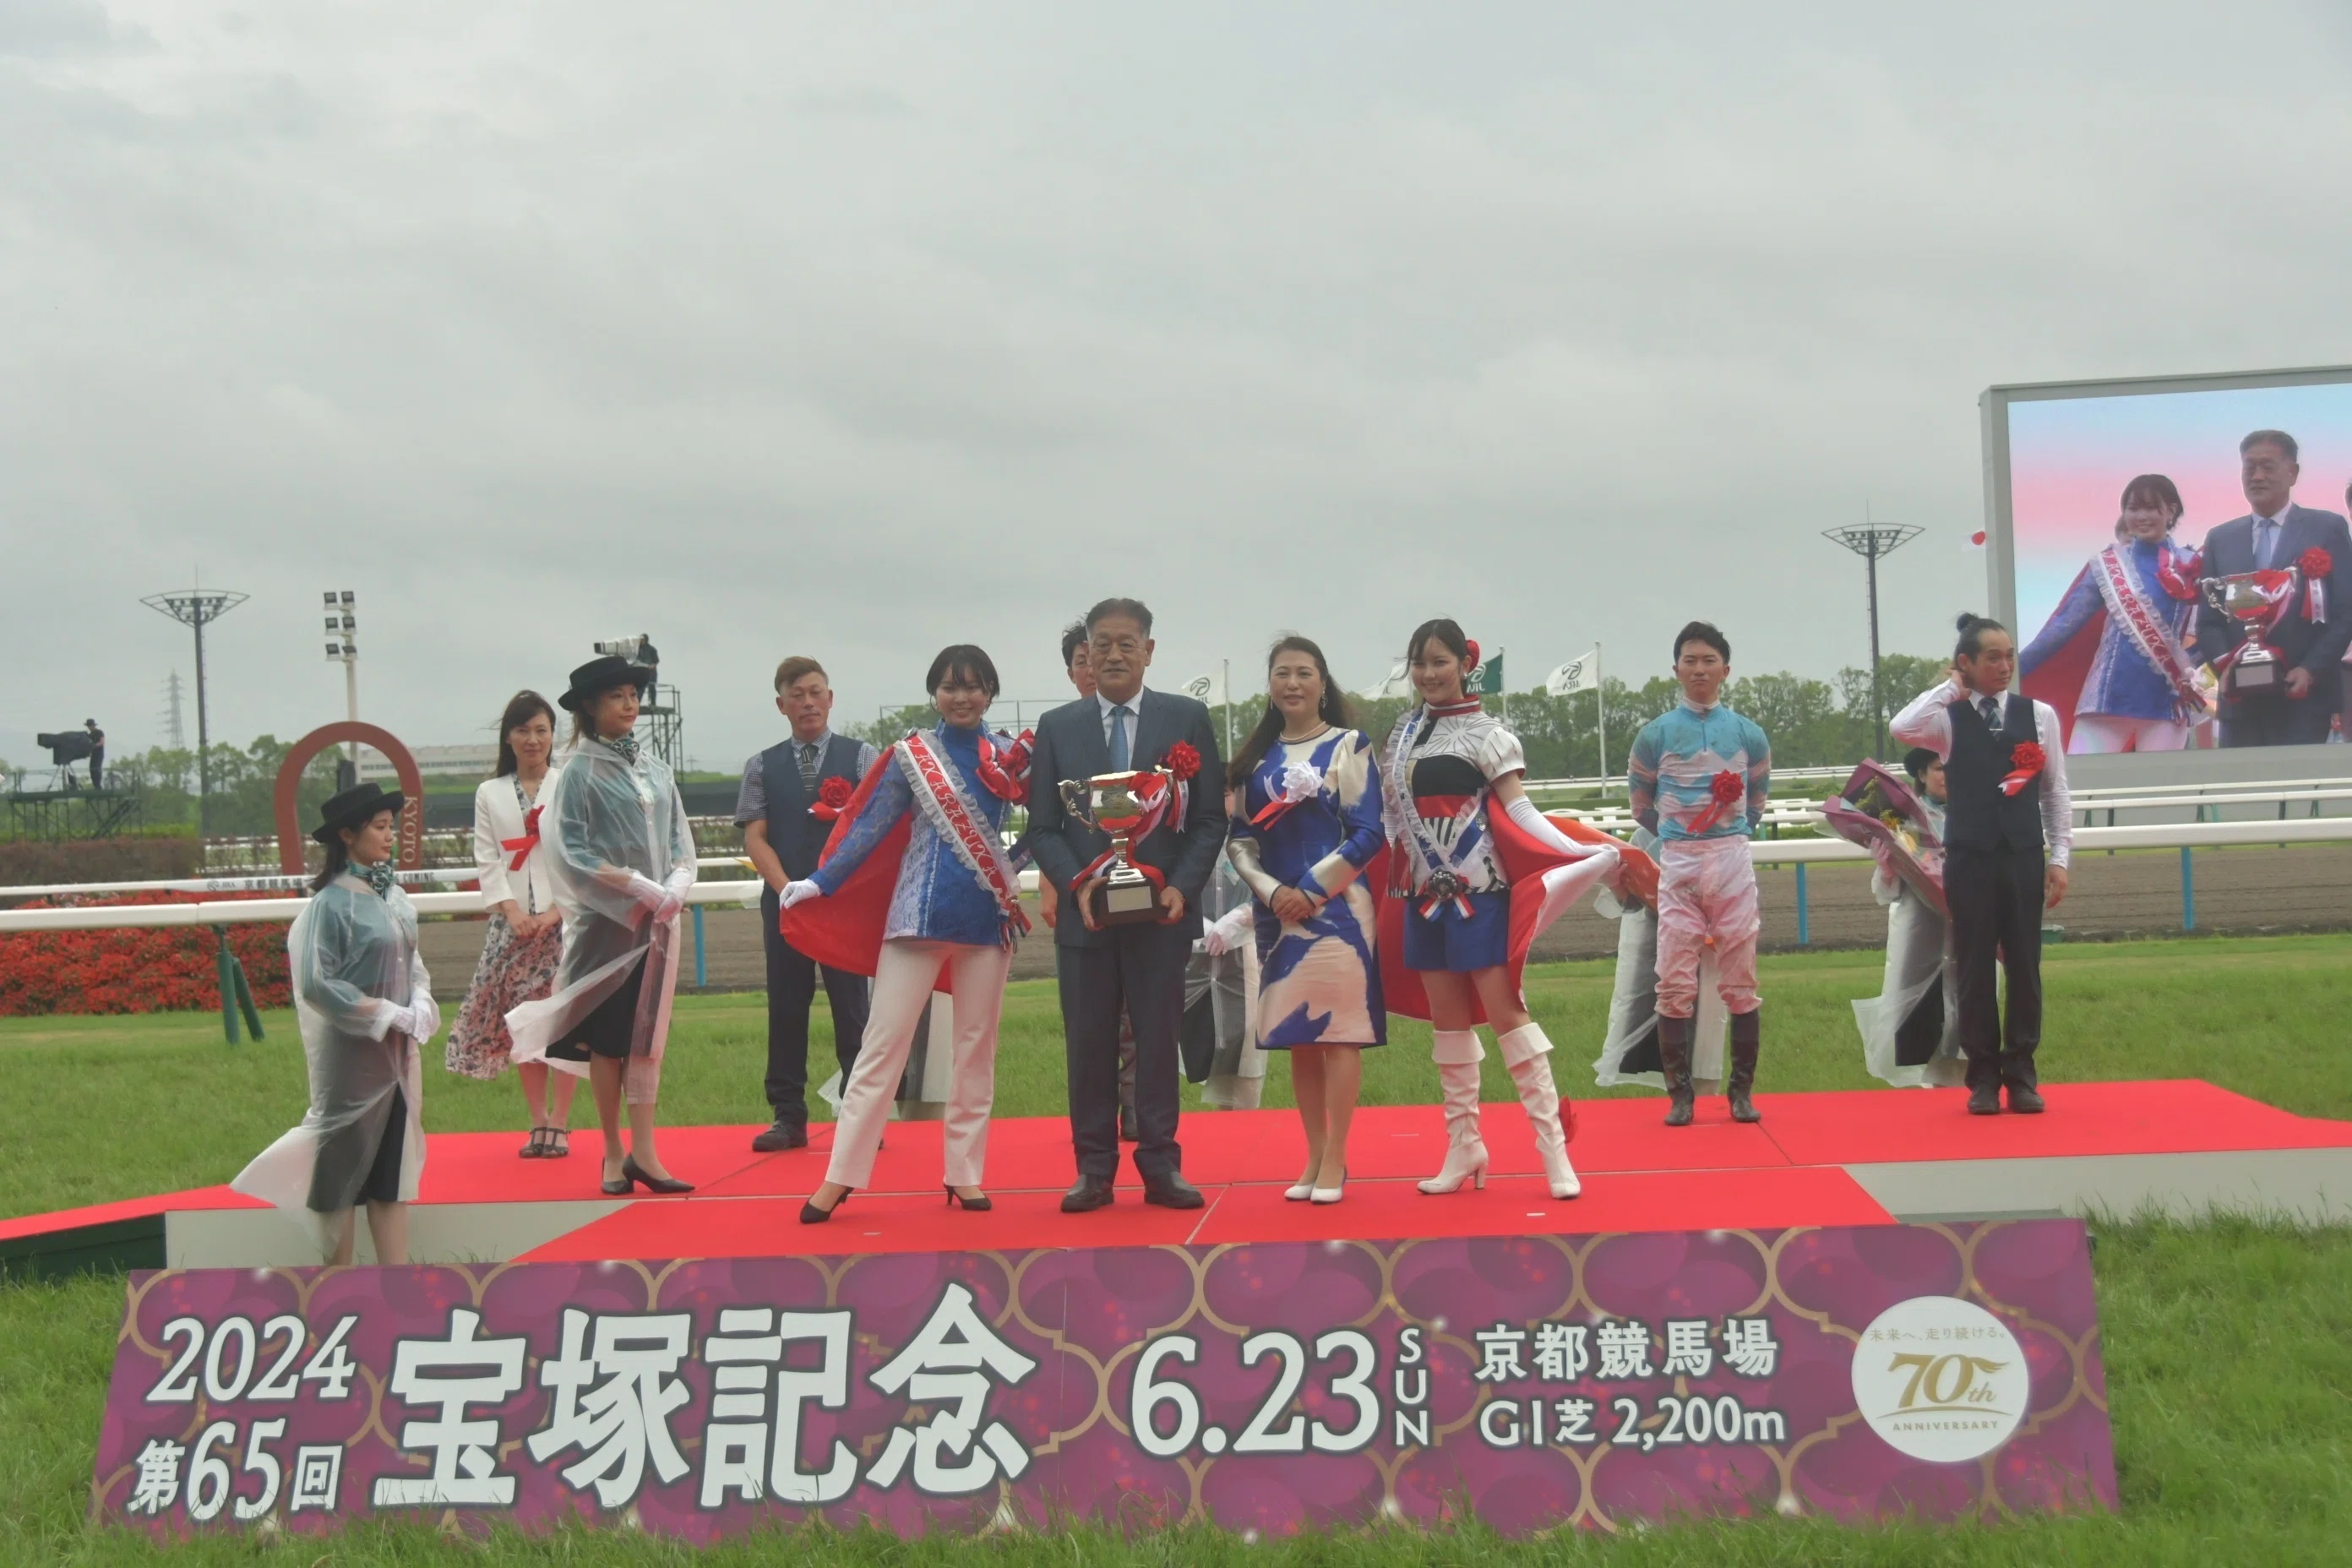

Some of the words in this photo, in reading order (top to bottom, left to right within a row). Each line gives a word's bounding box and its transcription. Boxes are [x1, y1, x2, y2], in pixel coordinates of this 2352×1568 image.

[402, 797, 418, 863] KYOTO
[906, 738, 999, 881] TAKARAZUKA
[145, 1315, 358, 1402] 2024
[1473, 1318, 1778, 1382] 京都競馬場
[1868, 1326, 2006, 1342] 未来へ、走り続ける。
[373, 1282, 1037, 1508] 宝塚記念
[1131, 1330, 1380, 1456] 6.23
[1395, 1328, 1429, 1446] SUN
[1611, 1396, 1785, 1451] 2,200m
[1892, 1419, 1999, 1432] ANNIVERSARY
[126, 1418, 343, 1521] 第65回
